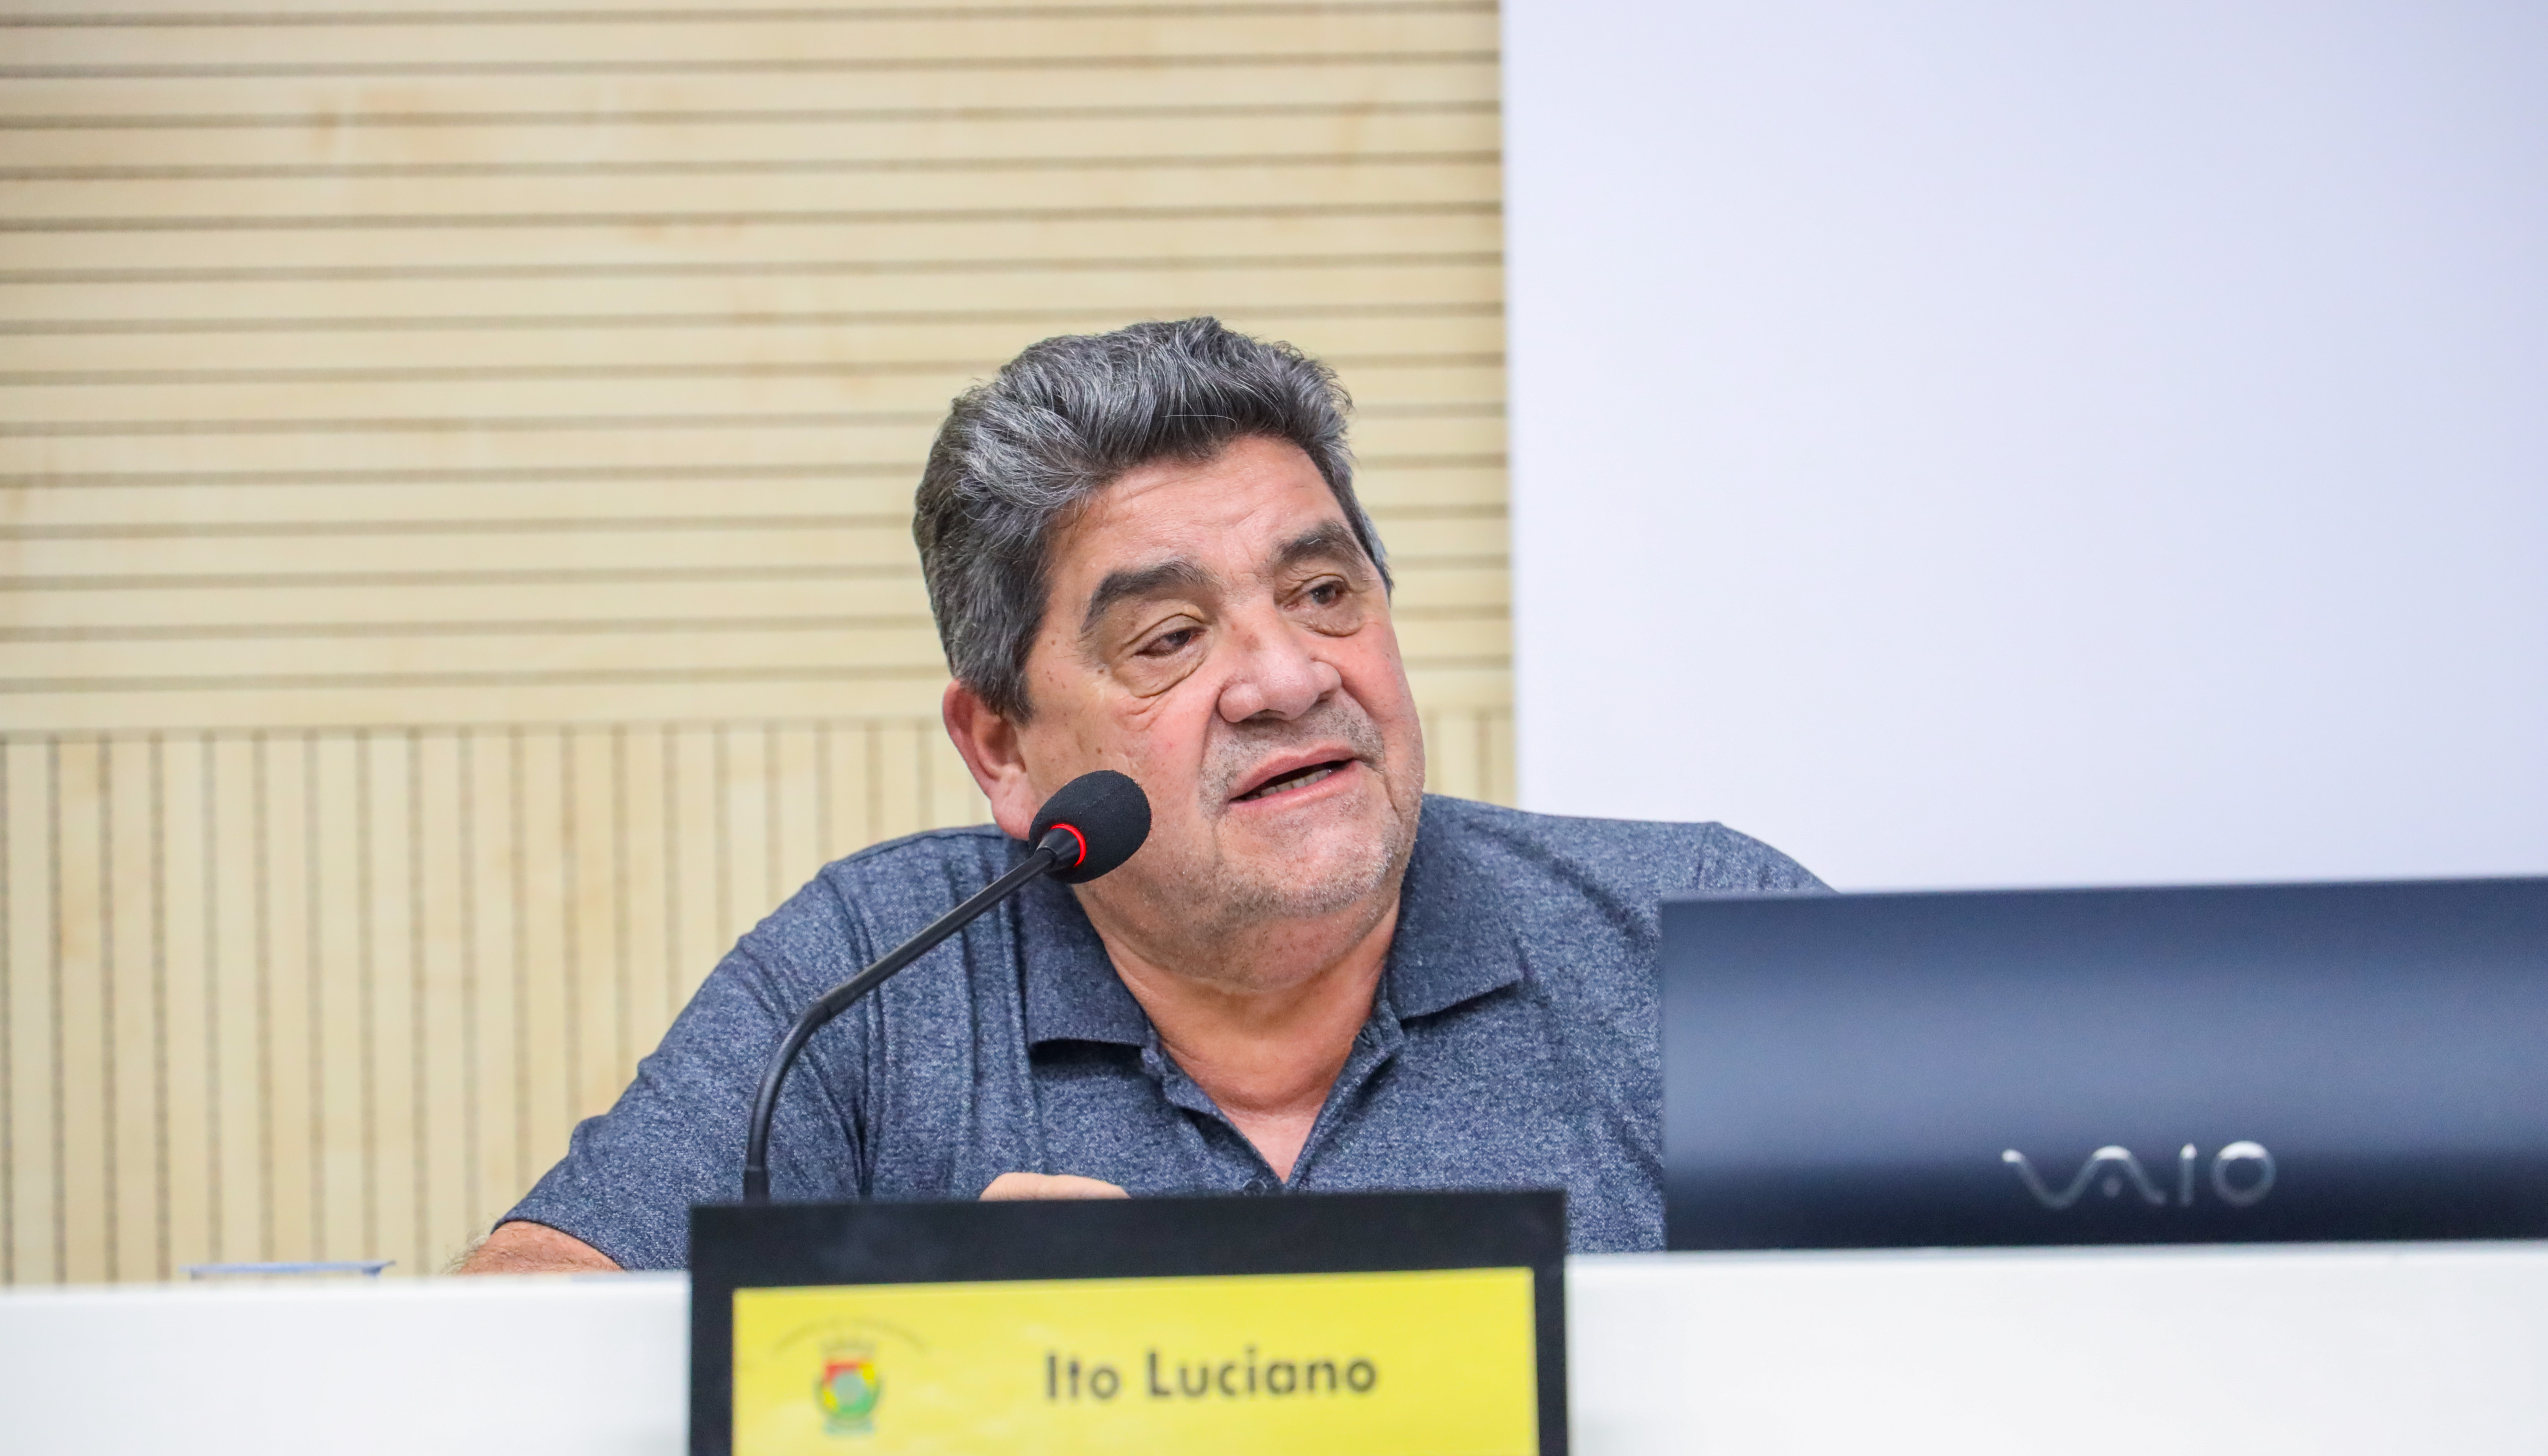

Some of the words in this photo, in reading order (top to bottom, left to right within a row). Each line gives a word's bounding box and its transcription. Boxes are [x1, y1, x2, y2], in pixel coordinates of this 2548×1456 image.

[2002, 1141, 2277, 1208] VAIO
[1046, 1353, 1121, 1400] Ito
[1147, 1347, 1377, 1398] Luciano
